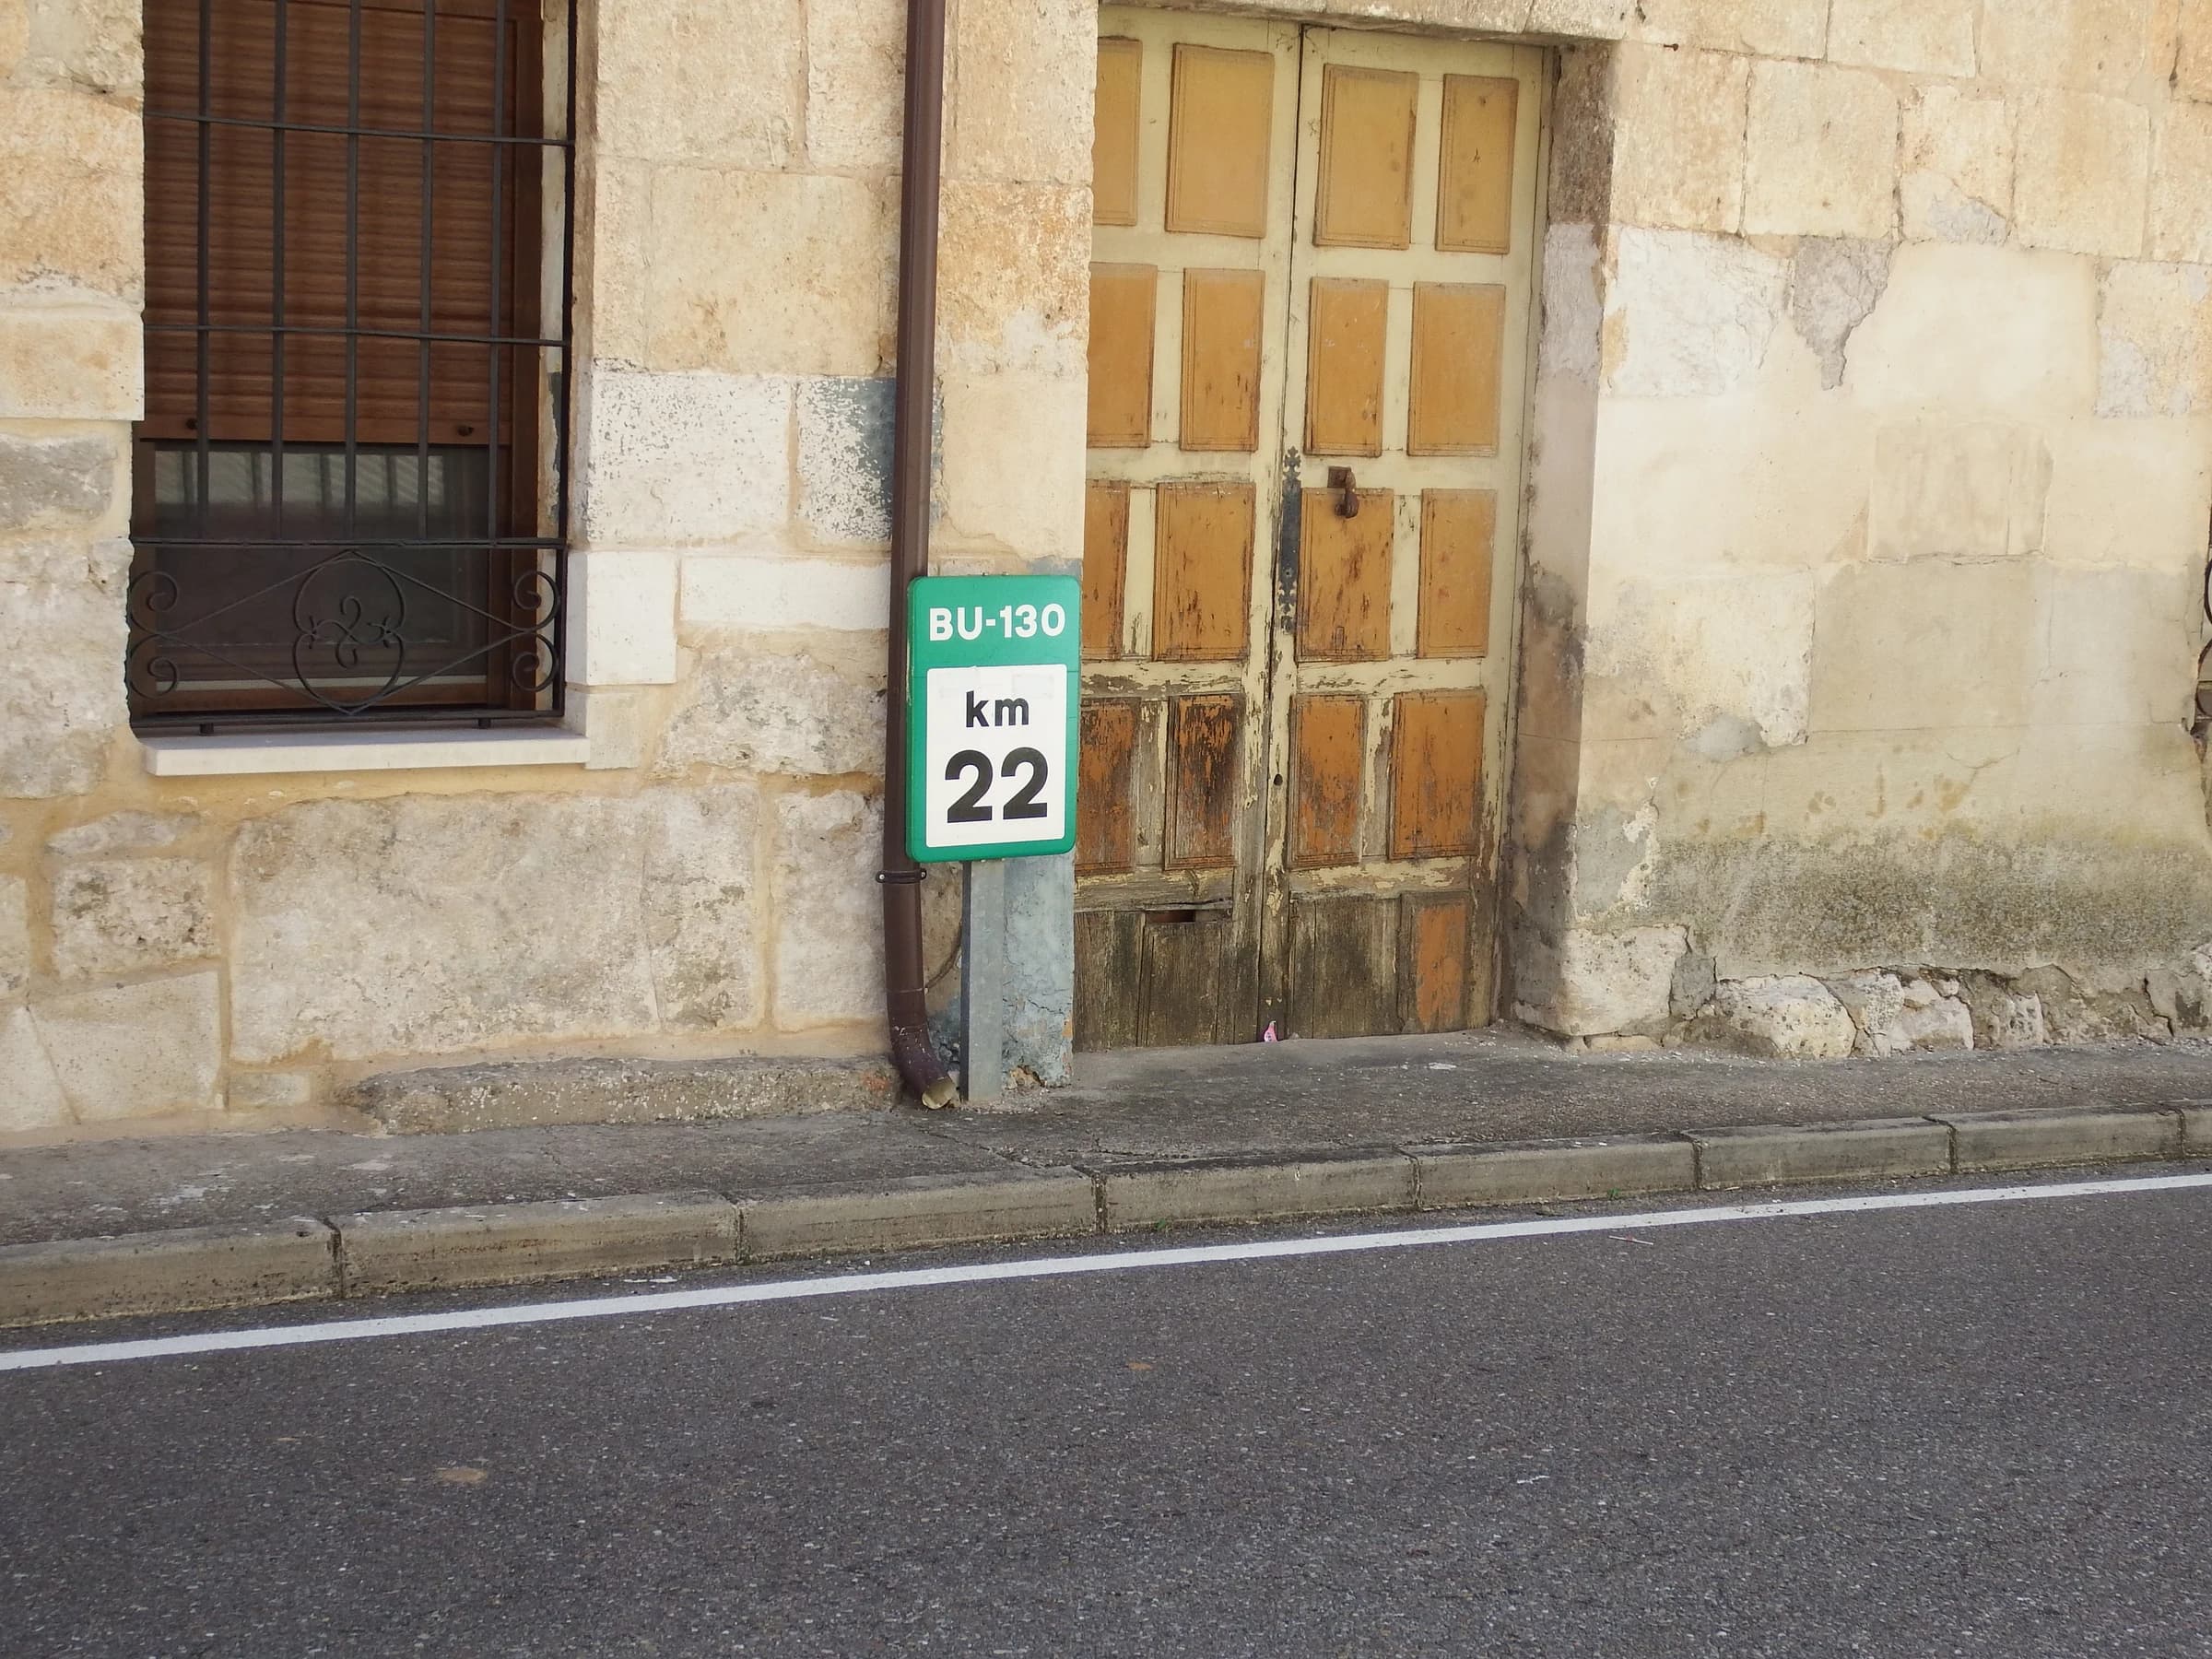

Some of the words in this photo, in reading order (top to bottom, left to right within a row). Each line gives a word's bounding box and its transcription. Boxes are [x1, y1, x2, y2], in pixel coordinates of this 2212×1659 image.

[929, 603, 1065, 641] BU-130
[966, 690, 1030, 728] km
[945, 747, 1048, 823] 22
